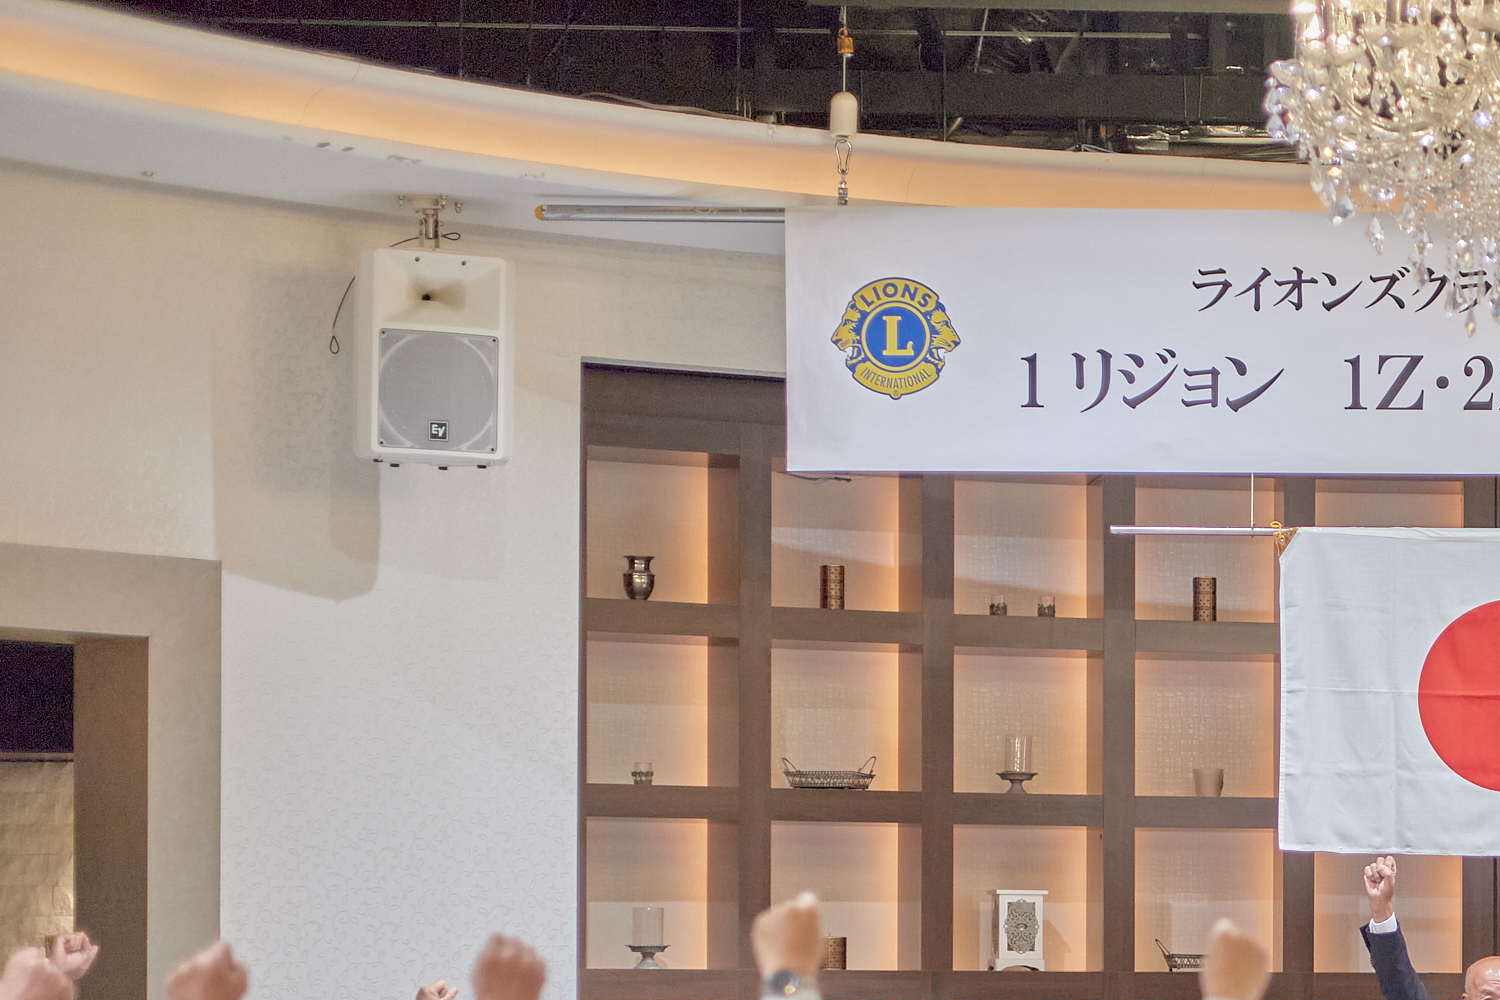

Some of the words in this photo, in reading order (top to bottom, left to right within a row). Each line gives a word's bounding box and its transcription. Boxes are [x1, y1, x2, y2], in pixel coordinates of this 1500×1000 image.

[859, 282, 933, 308] LIONS
[882, 315, 915, 356] L
[860, 367, 932, 389] INTERNATIONAL
[1021, 349, 1284, 413] 1リジョン
